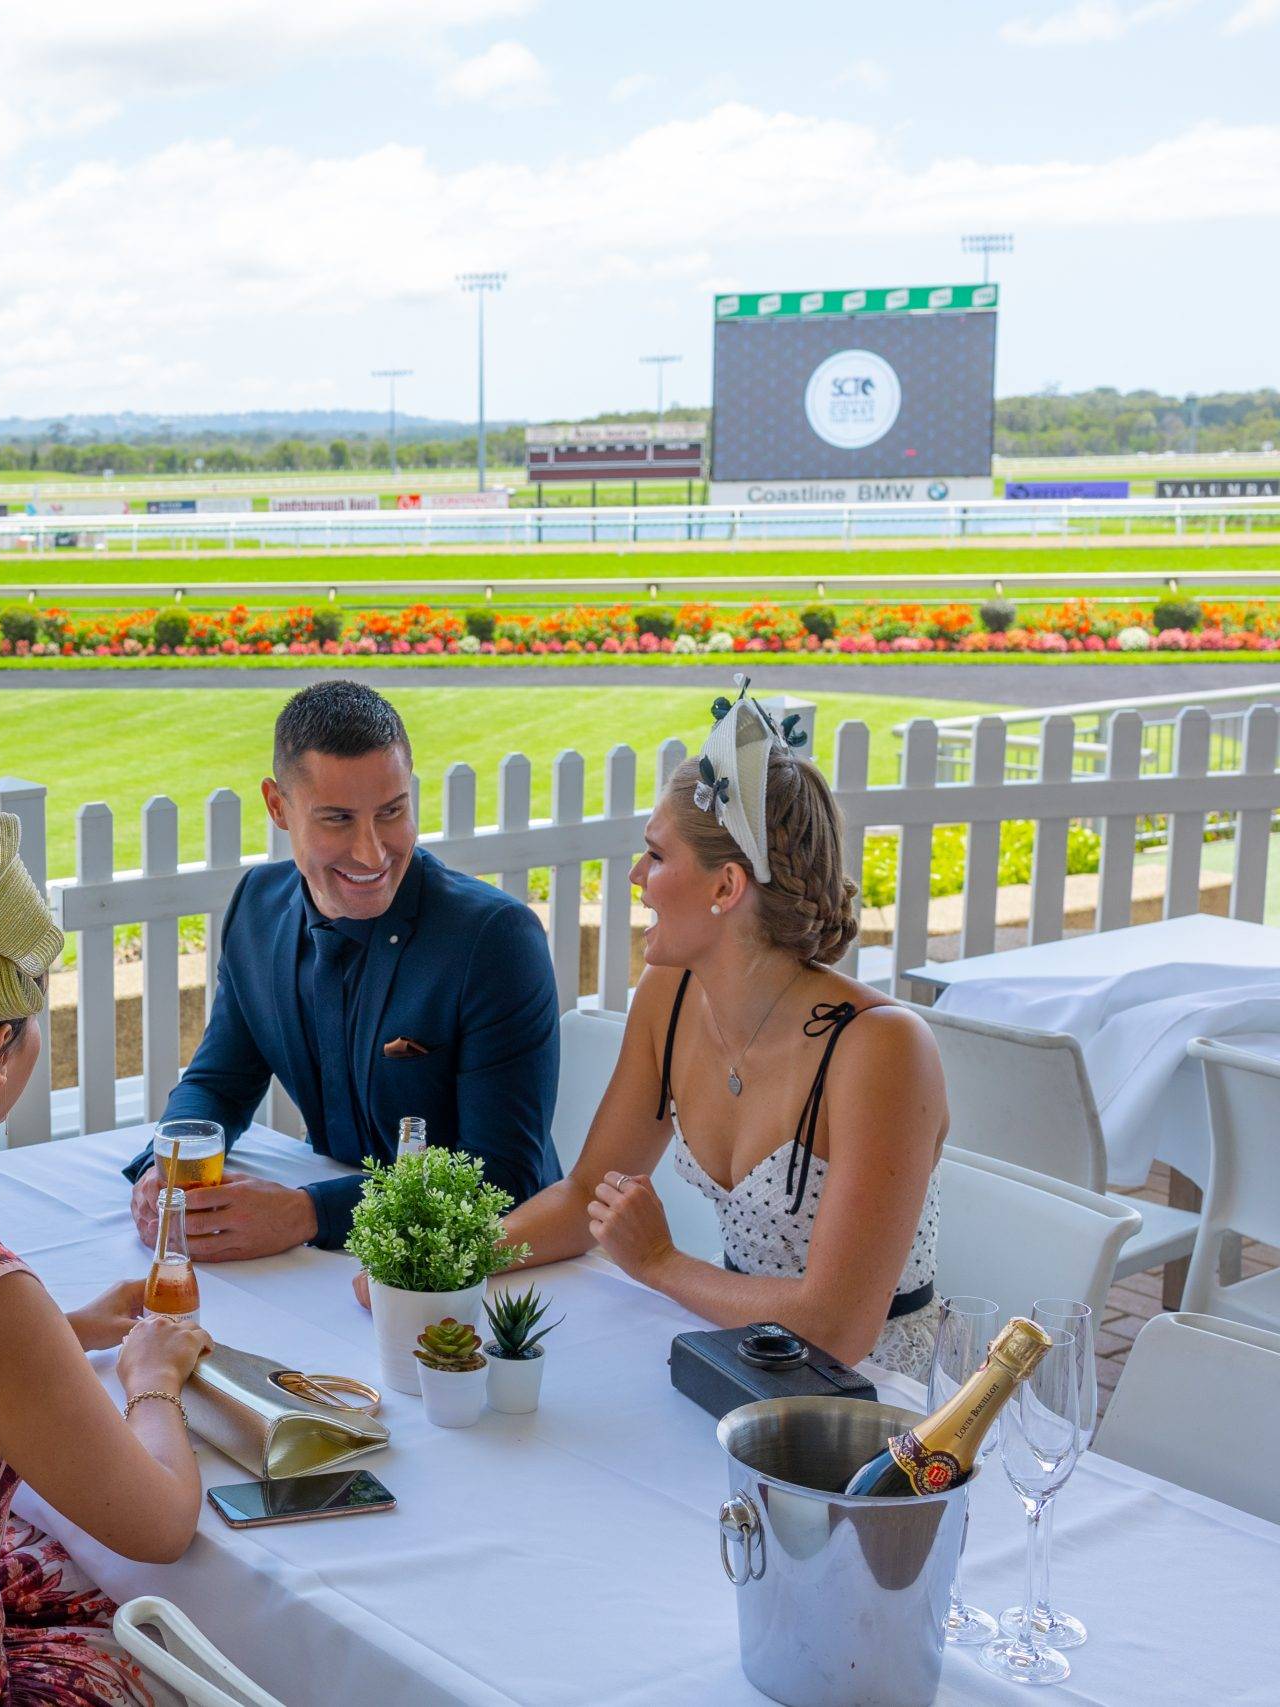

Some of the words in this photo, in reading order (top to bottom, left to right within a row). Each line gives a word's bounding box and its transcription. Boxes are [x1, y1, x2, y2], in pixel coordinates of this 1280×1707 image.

[747, 485, 846, 504] Coastline
[857, 484, 914, 501] BMW
[954, 1417, 974, 1439] LOUIS
[970, 1383, 1000, 1417] BOUILLOT
